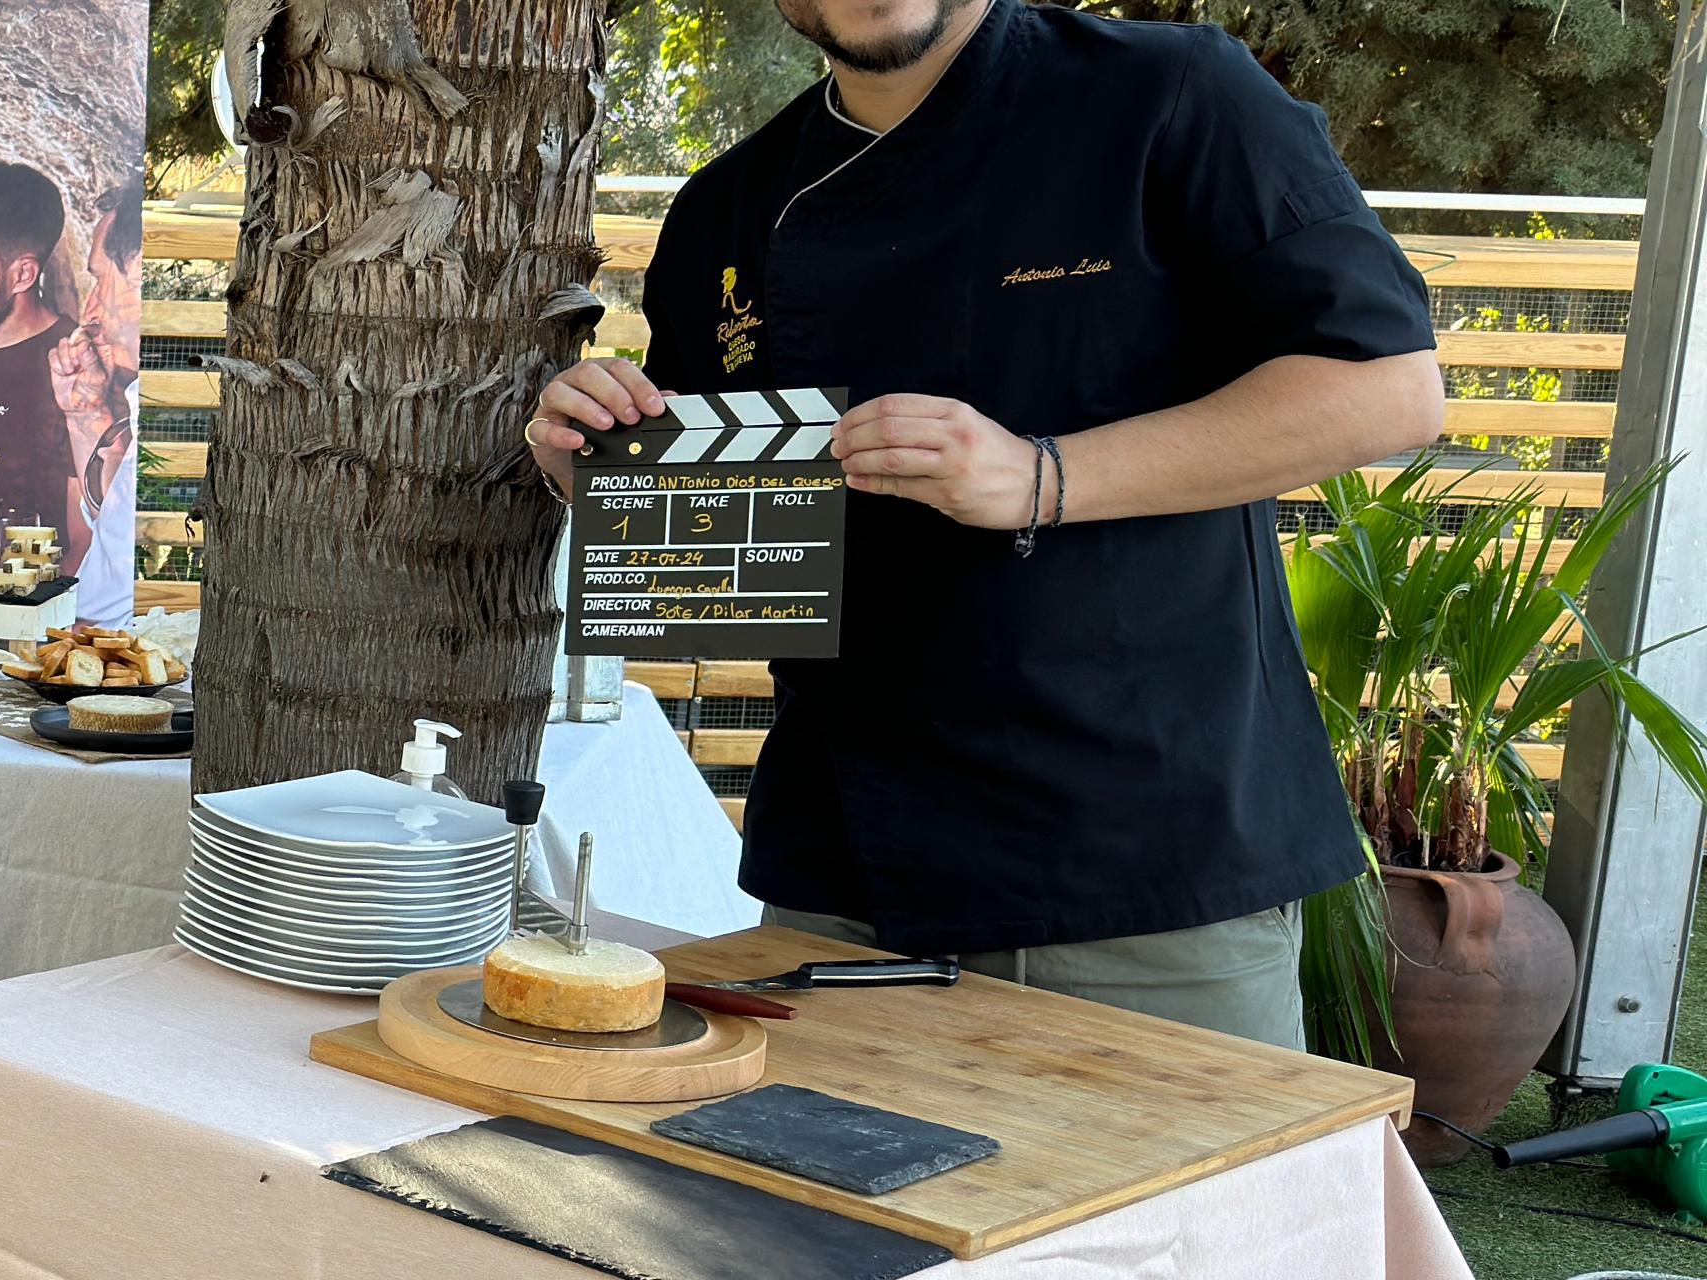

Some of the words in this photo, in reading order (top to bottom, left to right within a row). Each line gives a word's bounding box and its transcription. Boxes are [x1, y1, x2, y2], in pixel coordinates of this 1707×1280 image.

[1001, 266, 1066, 287] Antonio
[1069, 258, 1112, 275] Luis
[761, 477, 787, 487] DEL
[792, 477, 843, 488] QUESO
[601, 497, 654, 509] SCENE
[688, 495, 730, 508] TAKE
[772, 493, 816, 506] ROLL
[612, 516, 629, 540] 1
[690, 513, 713, 533] 3
[585, 551, 619, 563] DATE
[745, 548, 804, 563] SOUND
[585, 573, 647, 584] PROD.CO.
[583, 599, 651, 611] DIRECTOR
[713, 602, 754, 619] Pilar
[582, 624, 665, 637] CAMERAMAN
